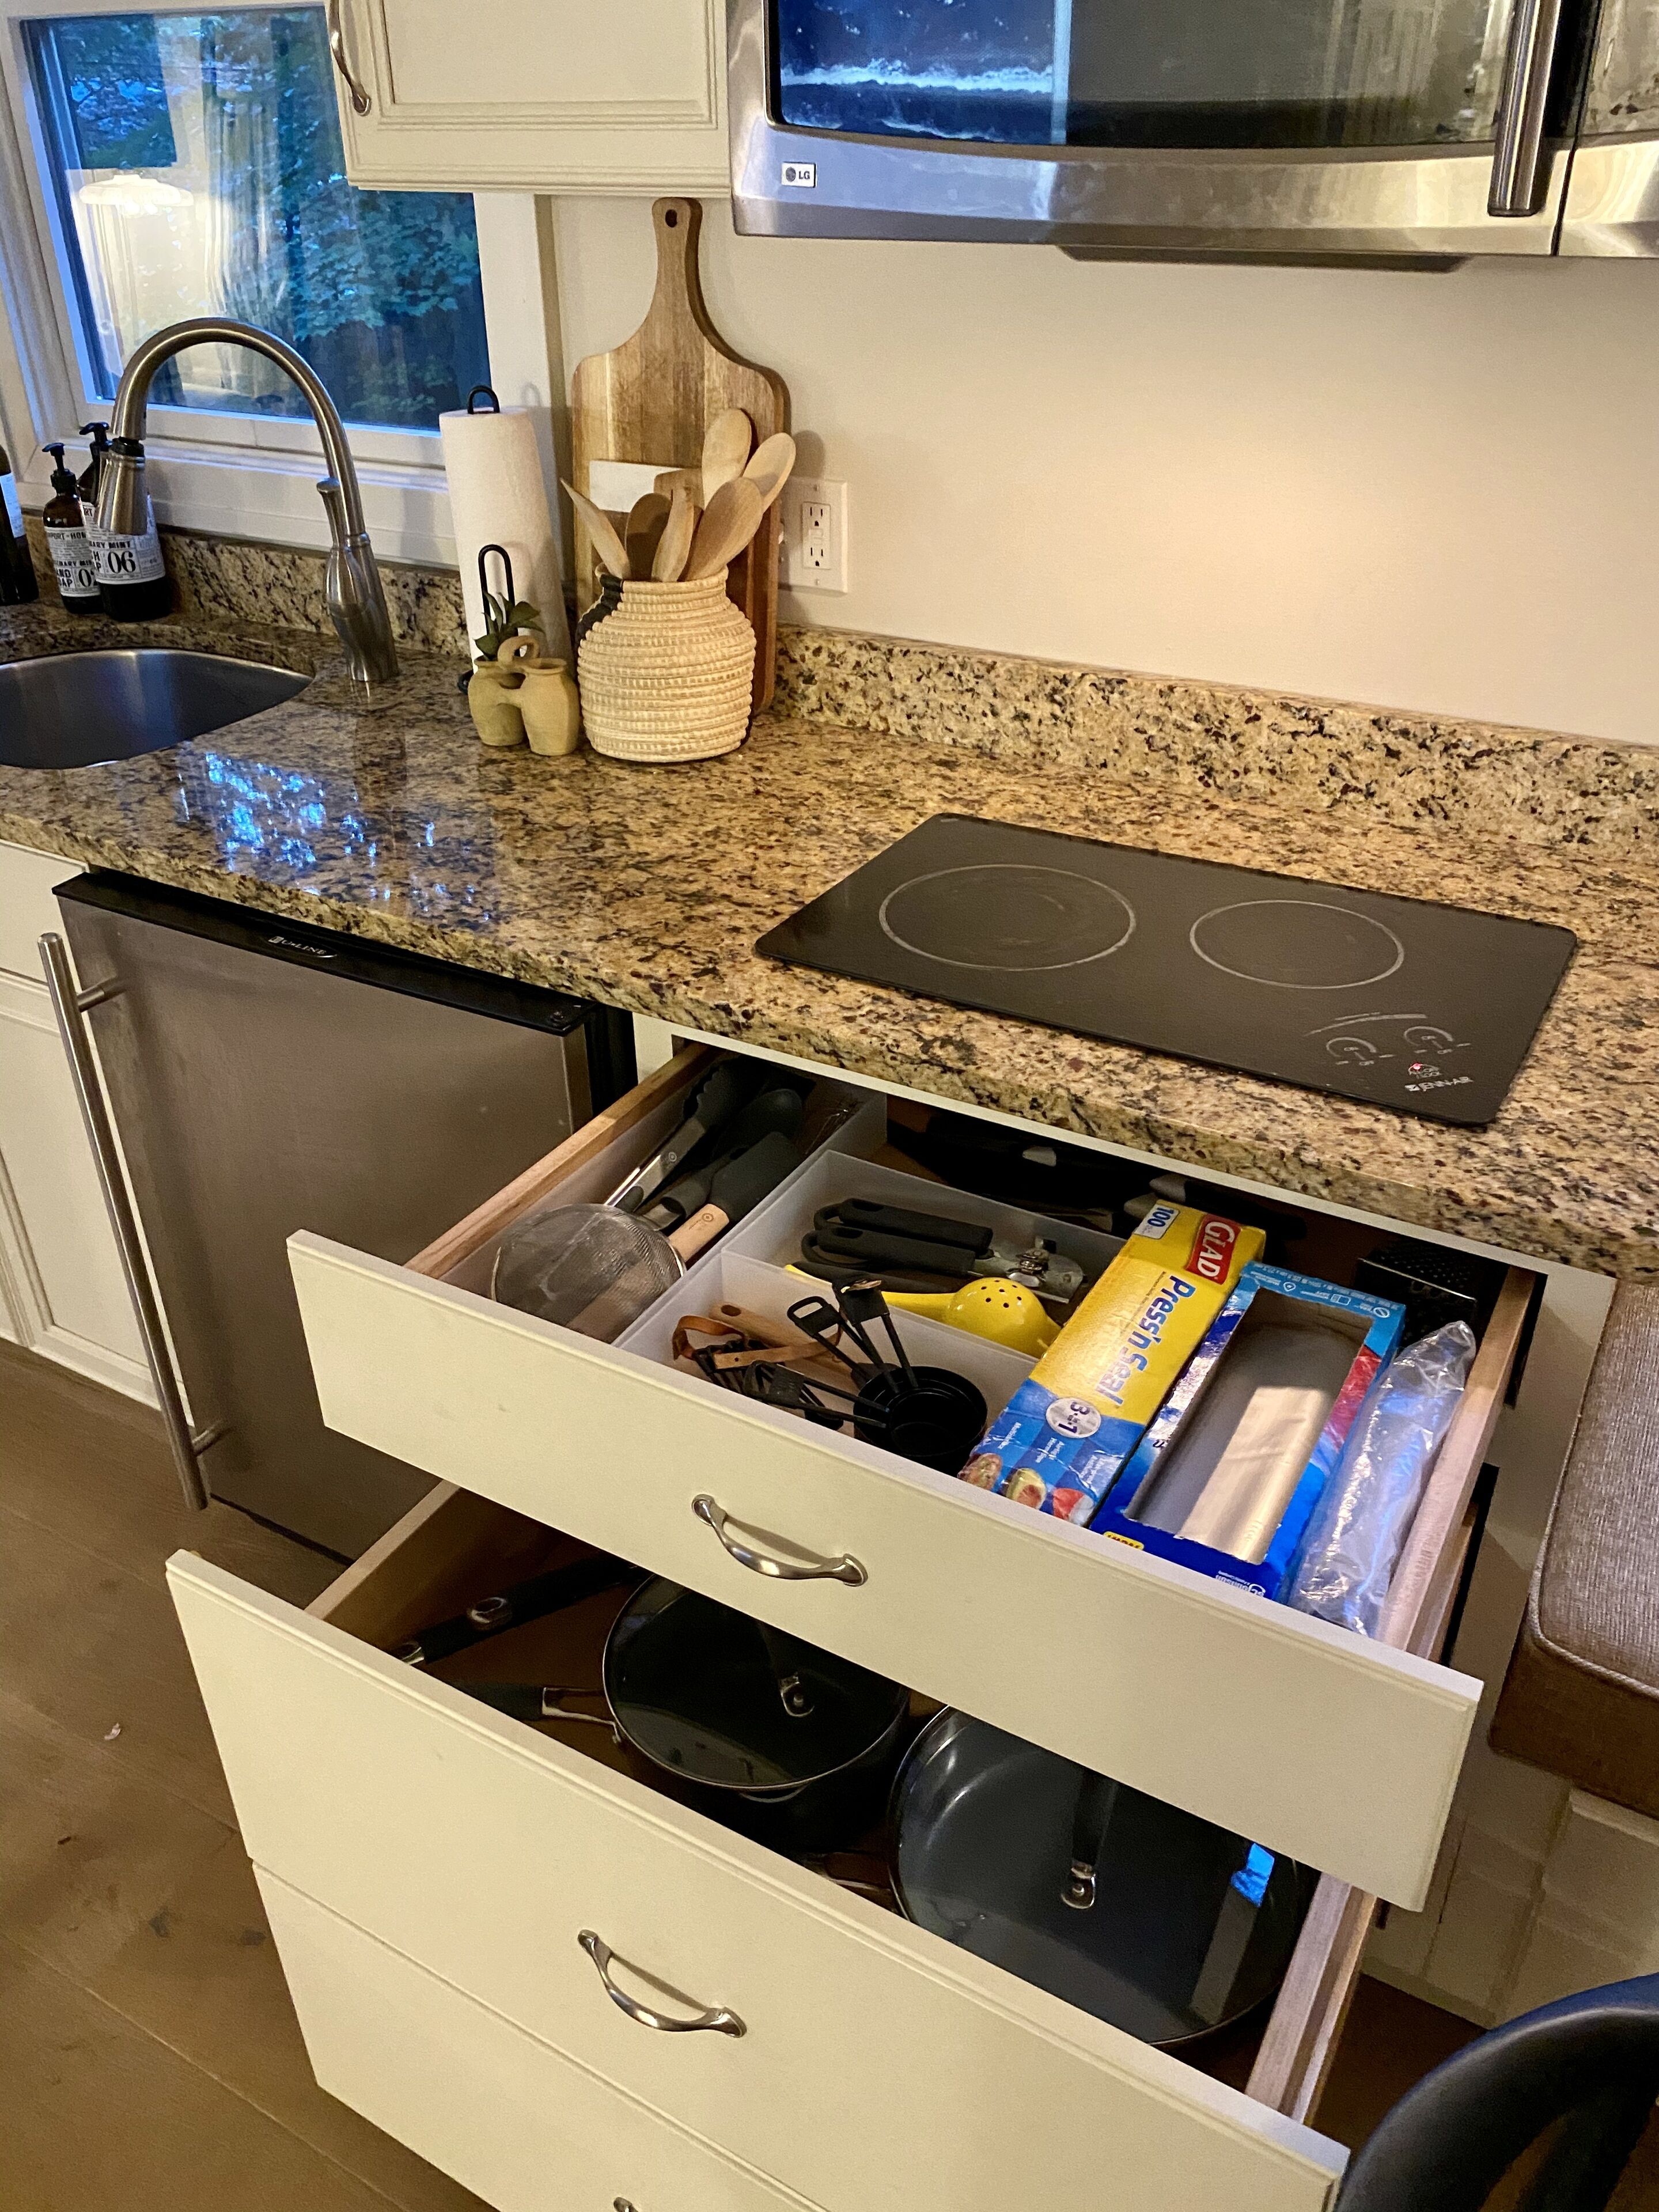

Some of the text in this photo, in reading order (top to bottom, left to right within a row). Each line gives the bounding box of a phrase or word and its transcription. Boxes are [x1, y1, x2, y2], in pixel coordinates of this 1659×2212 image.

[798, 171, 810, 180] LG
[109, 540, 131, 549] MINT
[107, 551, 136, 574] 06
[1147, 1207, 1175, 1227] 100
[1197, 1221, 1236, 1278] GLAD
[1095, 1346, 1149, 1406] Seal
